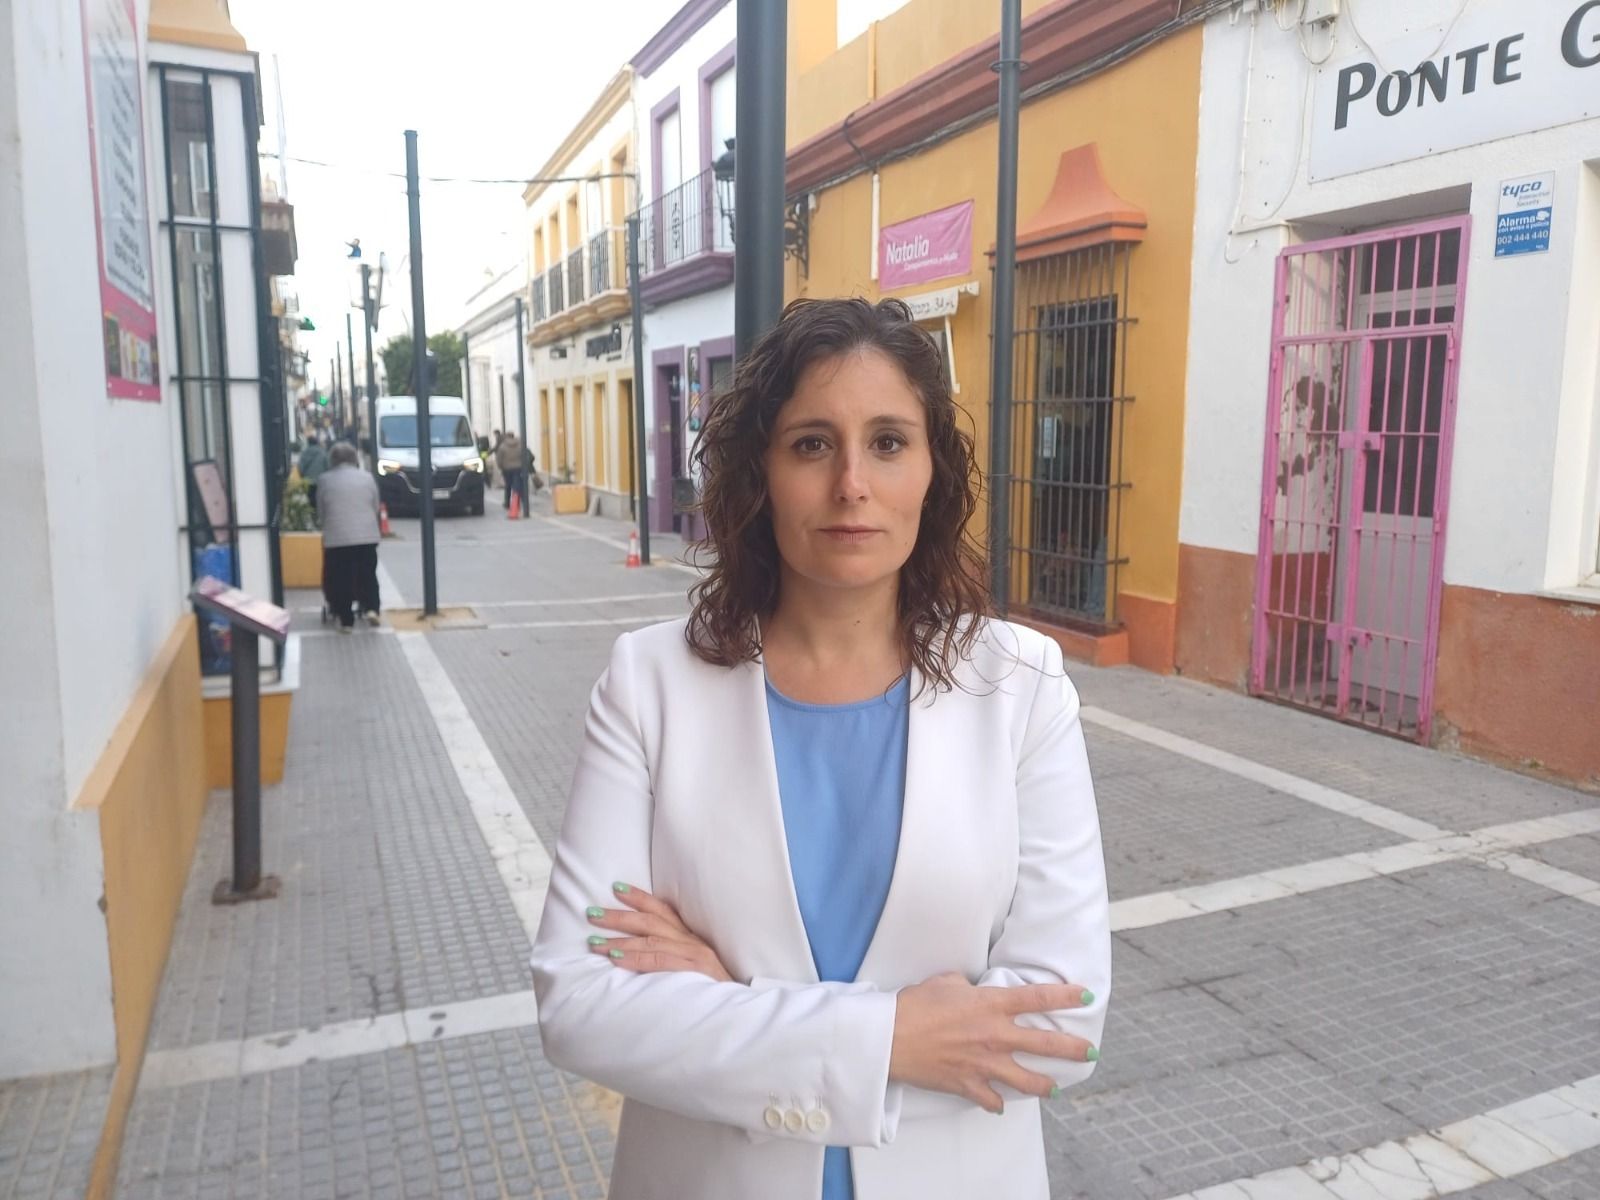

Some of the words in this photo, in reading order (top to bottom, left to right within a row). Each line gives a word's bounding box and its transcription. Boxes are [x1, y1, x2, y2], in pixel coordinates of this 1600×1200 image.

[1334, 32, 1525, 131] PONTE
[1502, 181, 1542, 197] tyco
[1498, 215, 1536, 227] Alarma
[1497, 235, 1512, 245] 902
[1513, 233, 1530, 242] 444
[1531, 230, 1549, 240] 440
[886, 234, 930, 265] Natalia
